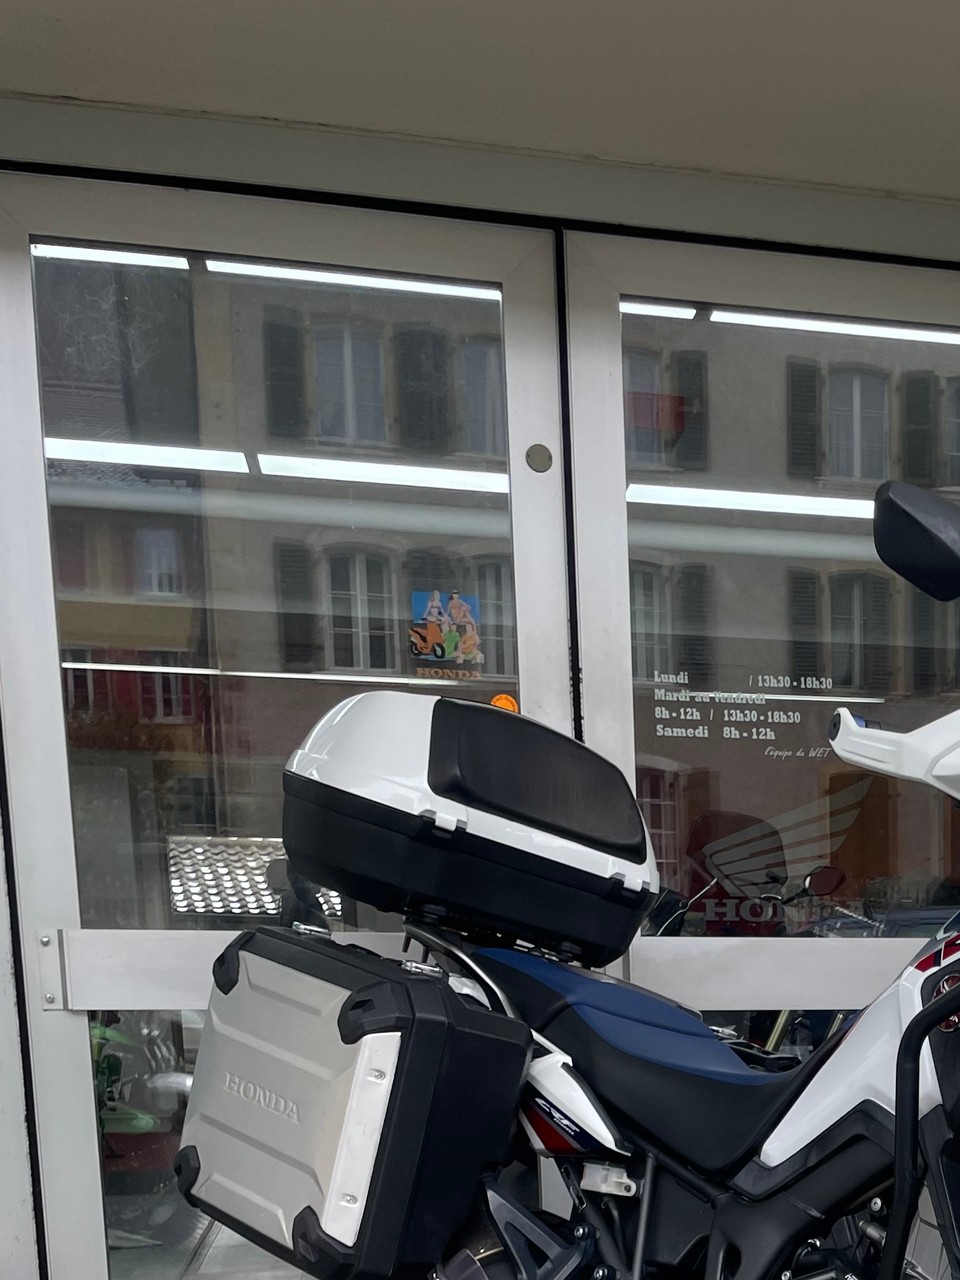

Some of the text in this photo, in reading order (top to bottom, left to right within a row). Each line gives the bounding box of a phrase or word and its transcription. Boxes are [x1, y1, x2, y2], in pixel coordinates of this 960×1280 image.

[416, 667, 481, 680] HONDA
[653, 670, 689, 684] Lundi
[757, 675, 791, 688] 13h30
[800, 677, 833, 690] 18h30
[654, 689, 767, 705] Mardi au Vendredi
[654, 706, 670, 719] 8h
[680, 708, 701, 720] 12h
[723, 709, 758, 722] 13h30
[767, 711, 800, 723] 18h30
[656, 724, 709, 738] Samedi
[722, 726, 740, 739] 8h
[751, 727, 776, 740] 12h
[222, 1071, 301, 1126] HONDA
[535, 1097, 580, 1132] CRF
